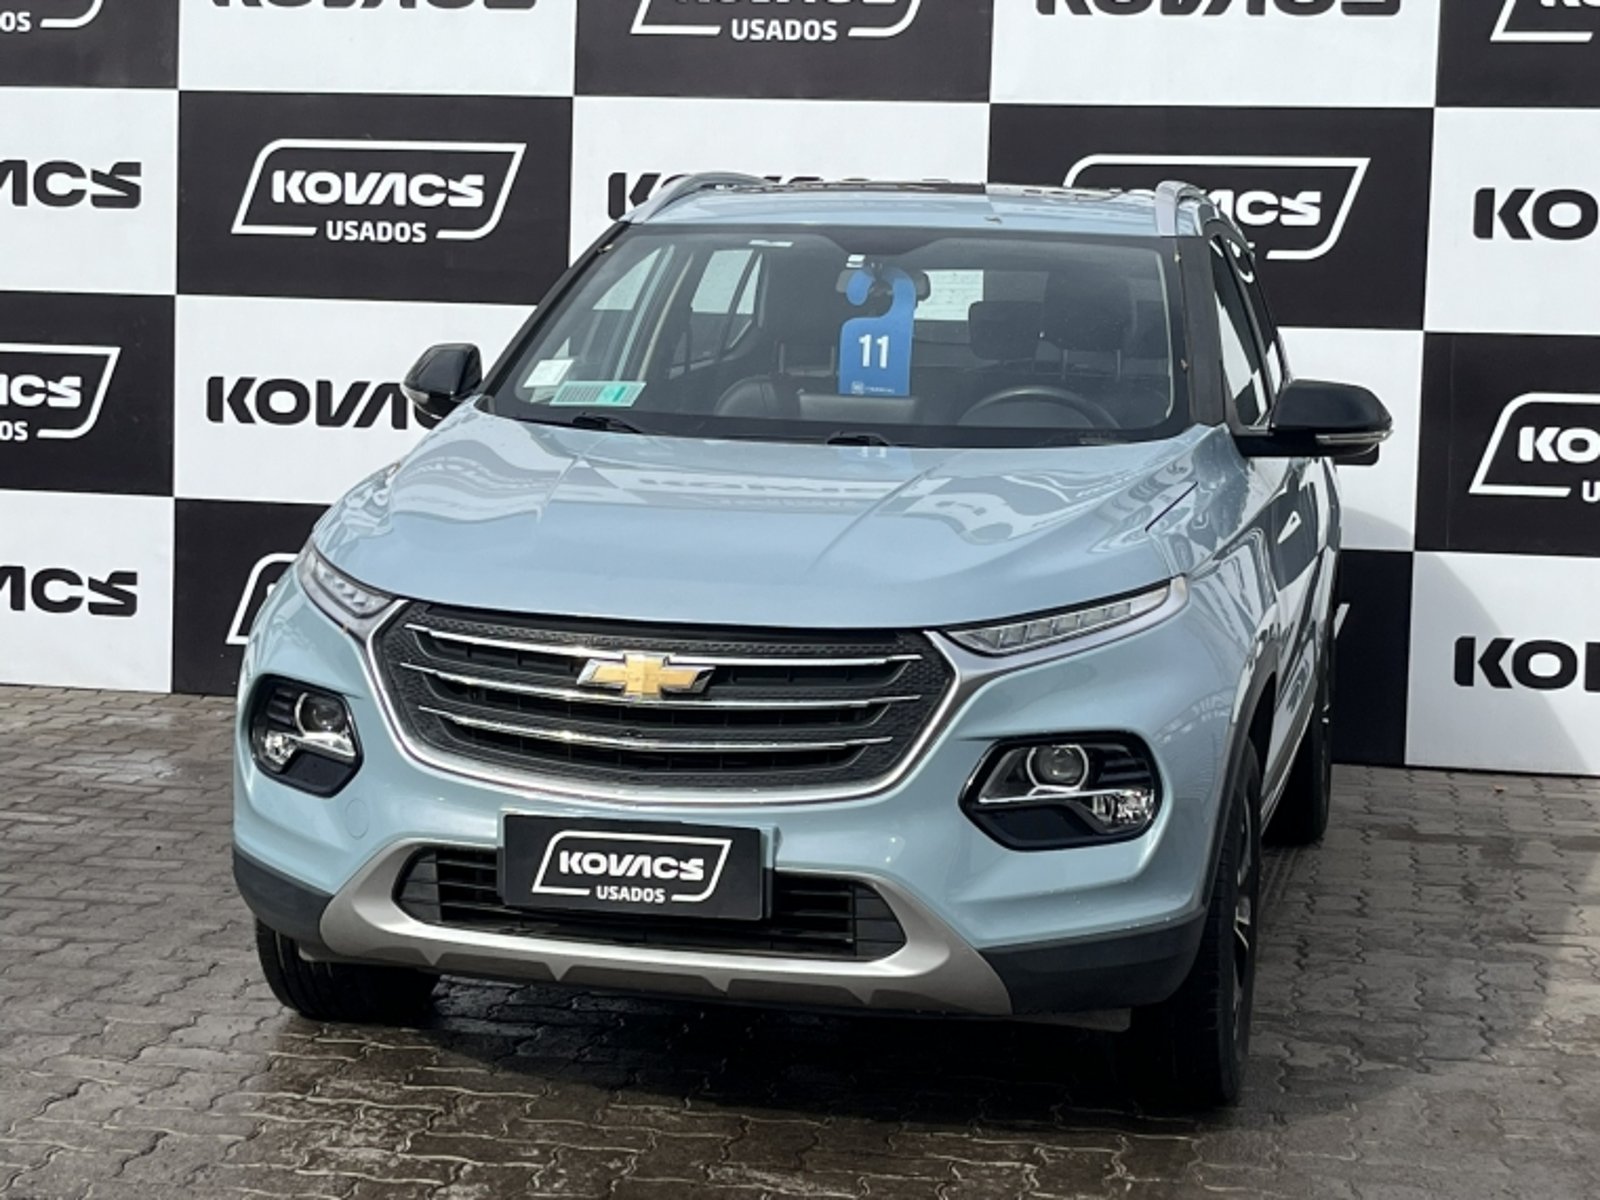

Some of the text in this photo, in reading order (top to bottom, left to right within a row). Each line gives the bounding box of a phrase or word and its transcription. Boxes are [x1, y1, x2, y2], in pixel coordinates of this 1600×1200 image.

[732, 19, 838, 41] USADOS
[271, 169, 485, 208] KOVACS
[326, 220, 427, 243] USADOS
[858, 334, 889, 369] 11
[559, 851, 704, 881] KOVACS
[596, 885, 665, 903] USADOS
